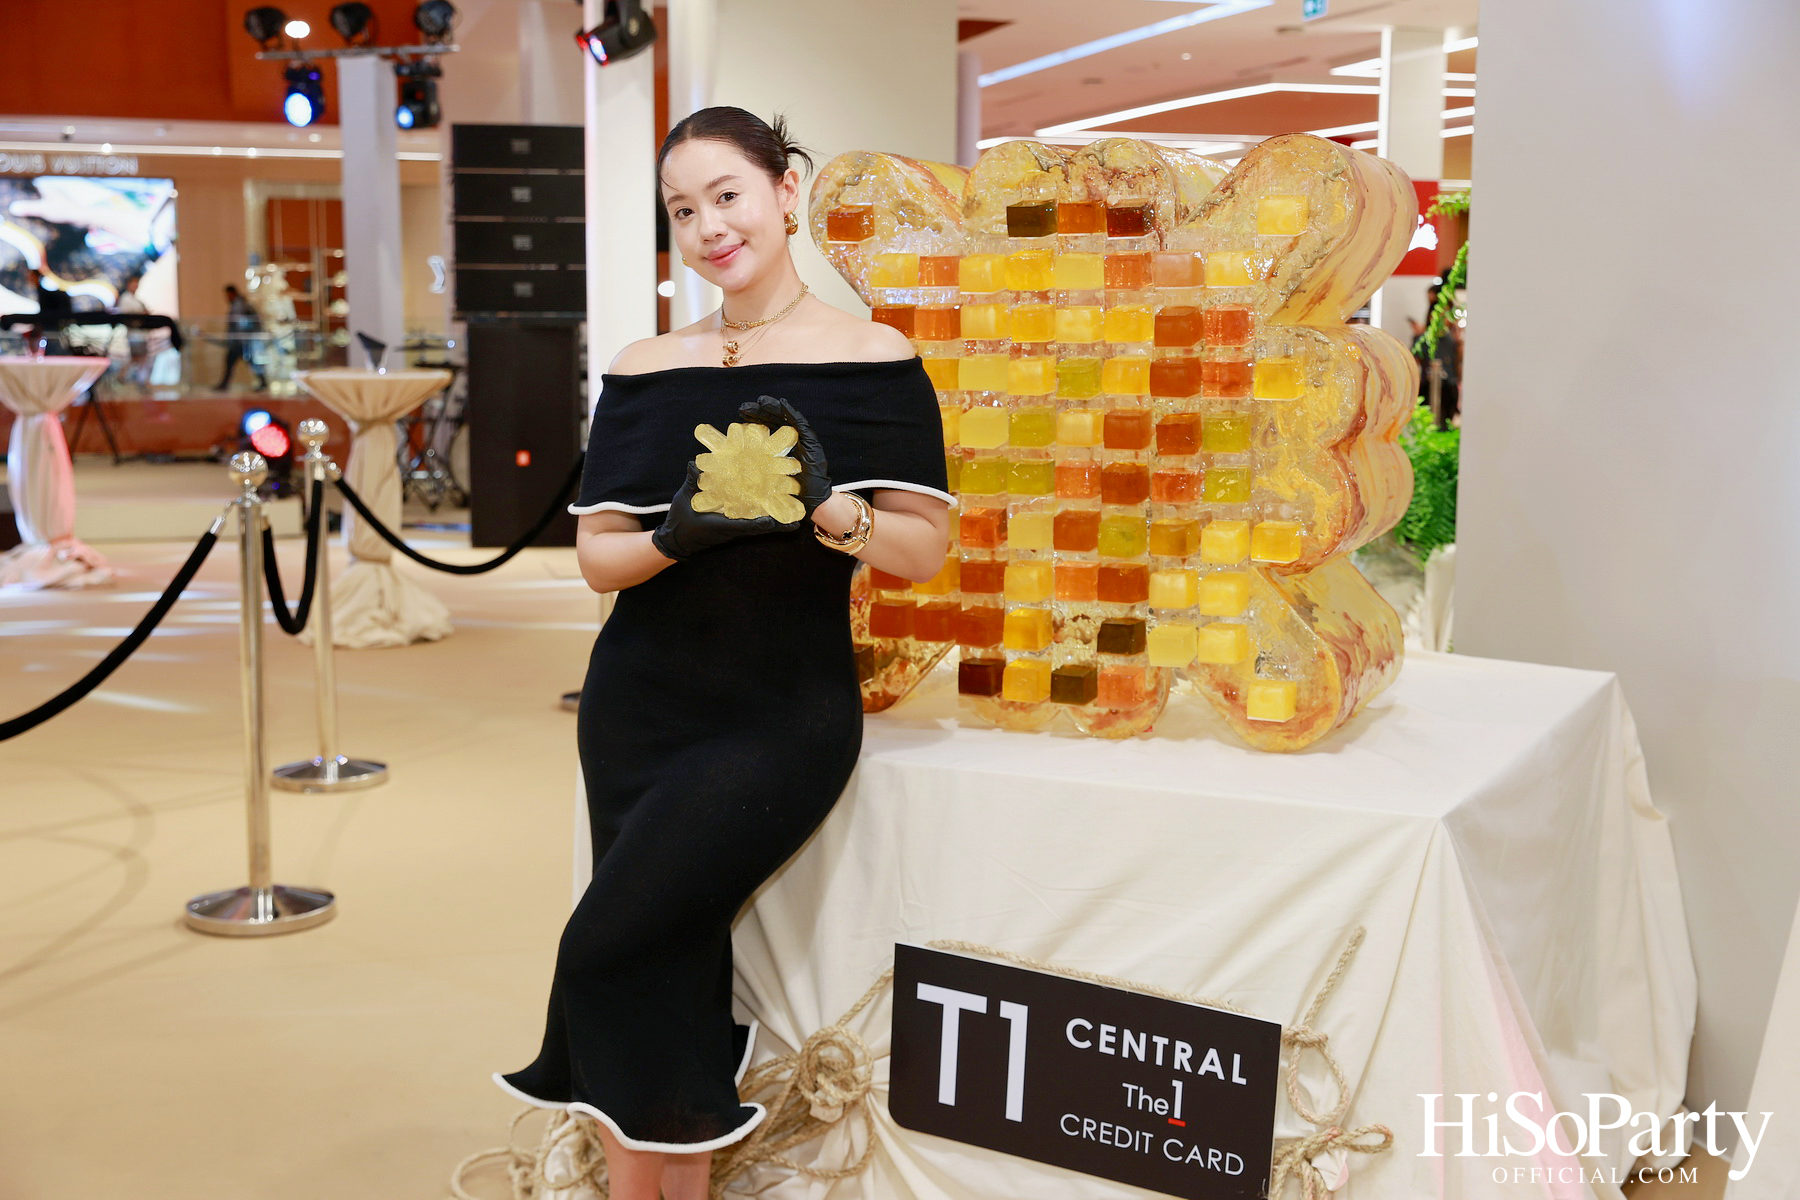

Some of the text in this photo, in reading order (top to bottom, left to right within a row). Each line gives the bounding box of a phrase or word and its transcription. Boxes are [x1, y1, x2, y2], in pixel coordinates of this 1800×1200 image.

[1065, 1017, 1248, 1086] CENTRAL
[1059, 1113, 1245, 1177] CREDIT CARD
